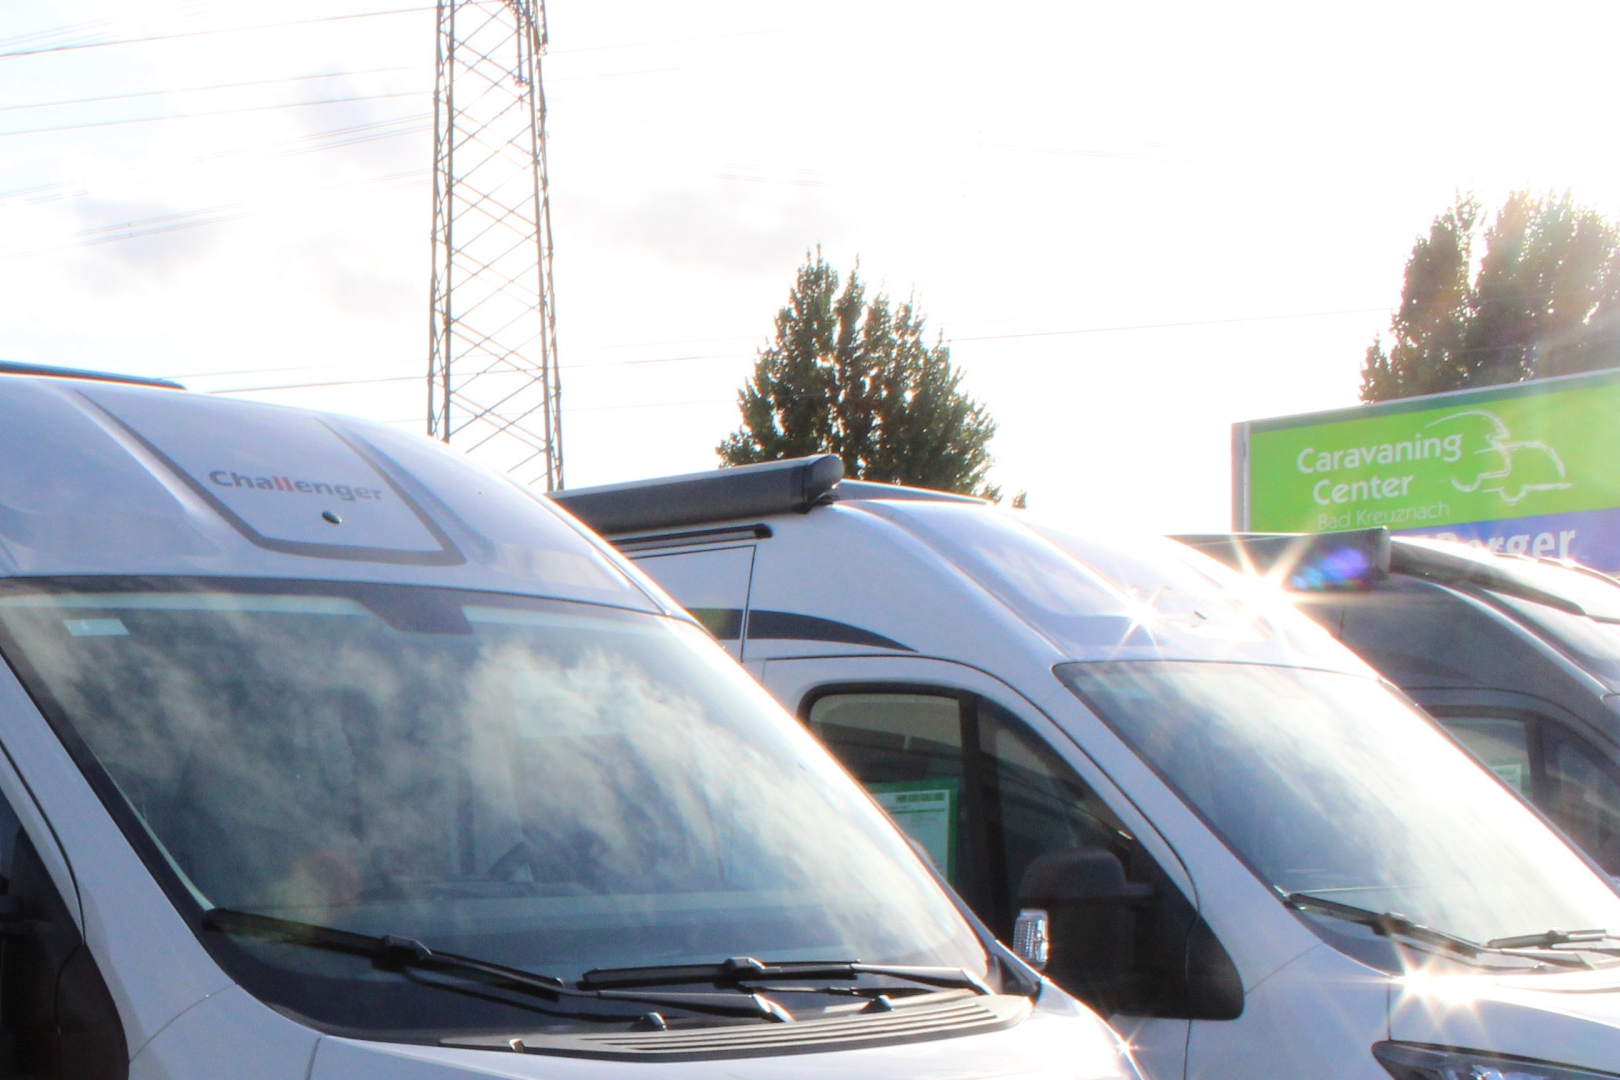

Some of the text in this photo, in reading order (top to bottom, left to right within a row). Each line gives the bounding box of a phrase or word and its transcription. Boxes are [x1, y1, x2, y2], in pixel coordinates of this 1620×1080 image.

[1298, 433, 1463, 475] Caravaning
[208, 471, 382, 502] Challenger
[1312, 475, 1414, 506] Center
[1317, 500, 1450, 532] Bad Kreuznach
